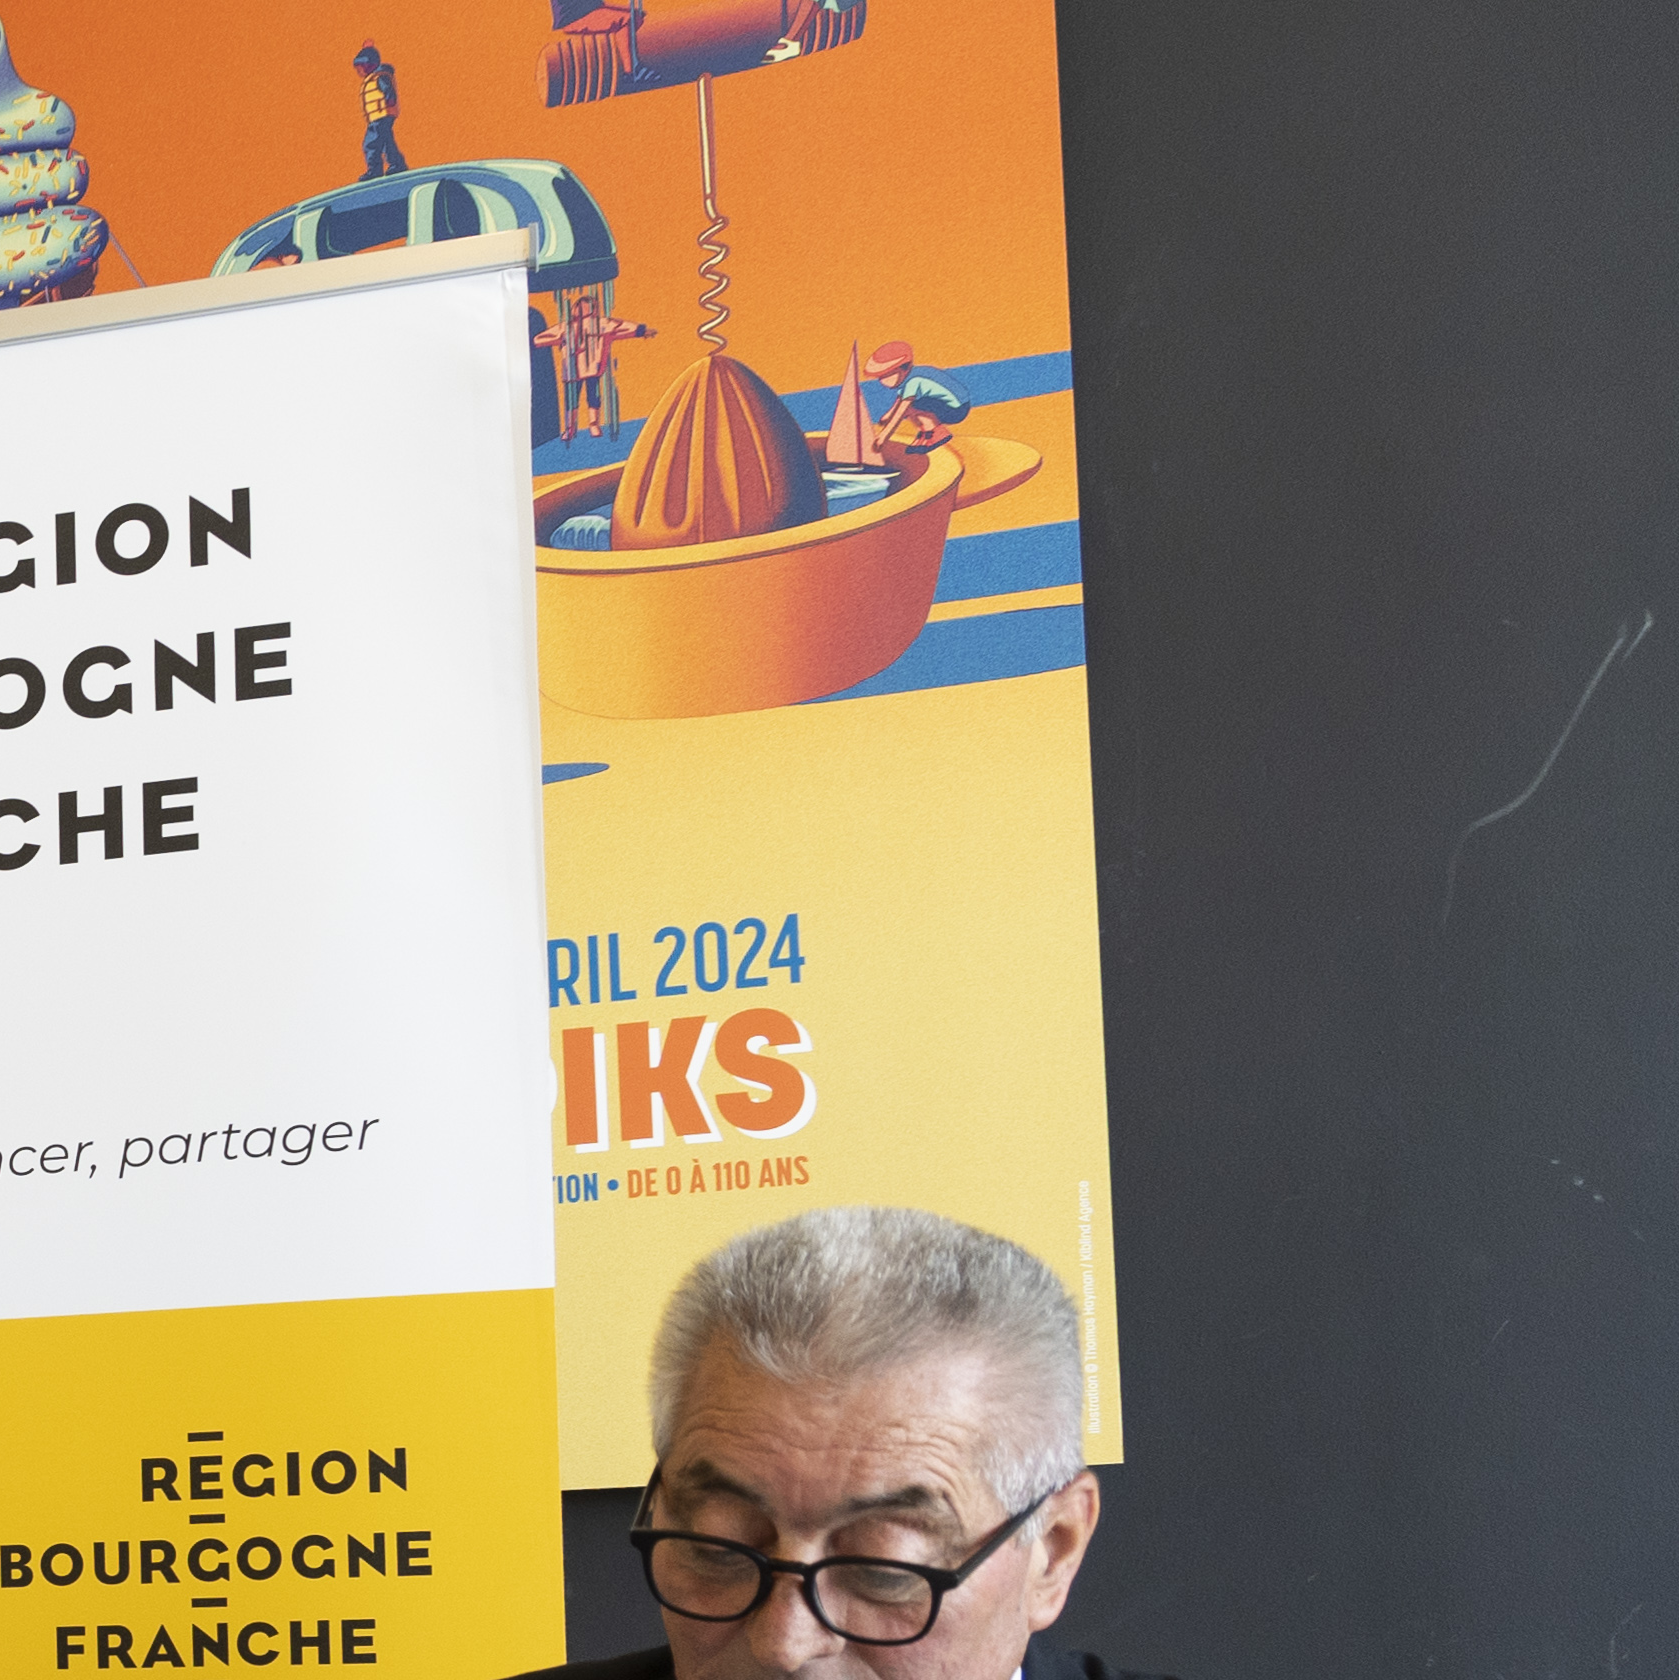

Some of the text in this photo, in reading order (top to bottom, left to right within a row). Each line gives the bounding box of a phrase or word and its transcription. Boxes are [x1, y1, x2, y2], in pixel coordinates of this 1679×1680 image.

[653, 913, 806, 997] 2024
[118, 1115, 380, 1180] partager
[553, 1173, 599, 1204] ION
[627, 1167, 658, 1198] DE
[689, 1158, 706, 1194] À
[713, 1160, 751, 1192] 110
[758, 1156, 810, 1188] ANS
[0, 1531, 433, 1589] BOURGOGNE
[56, 1619, 377, 1670] FRANCHE
